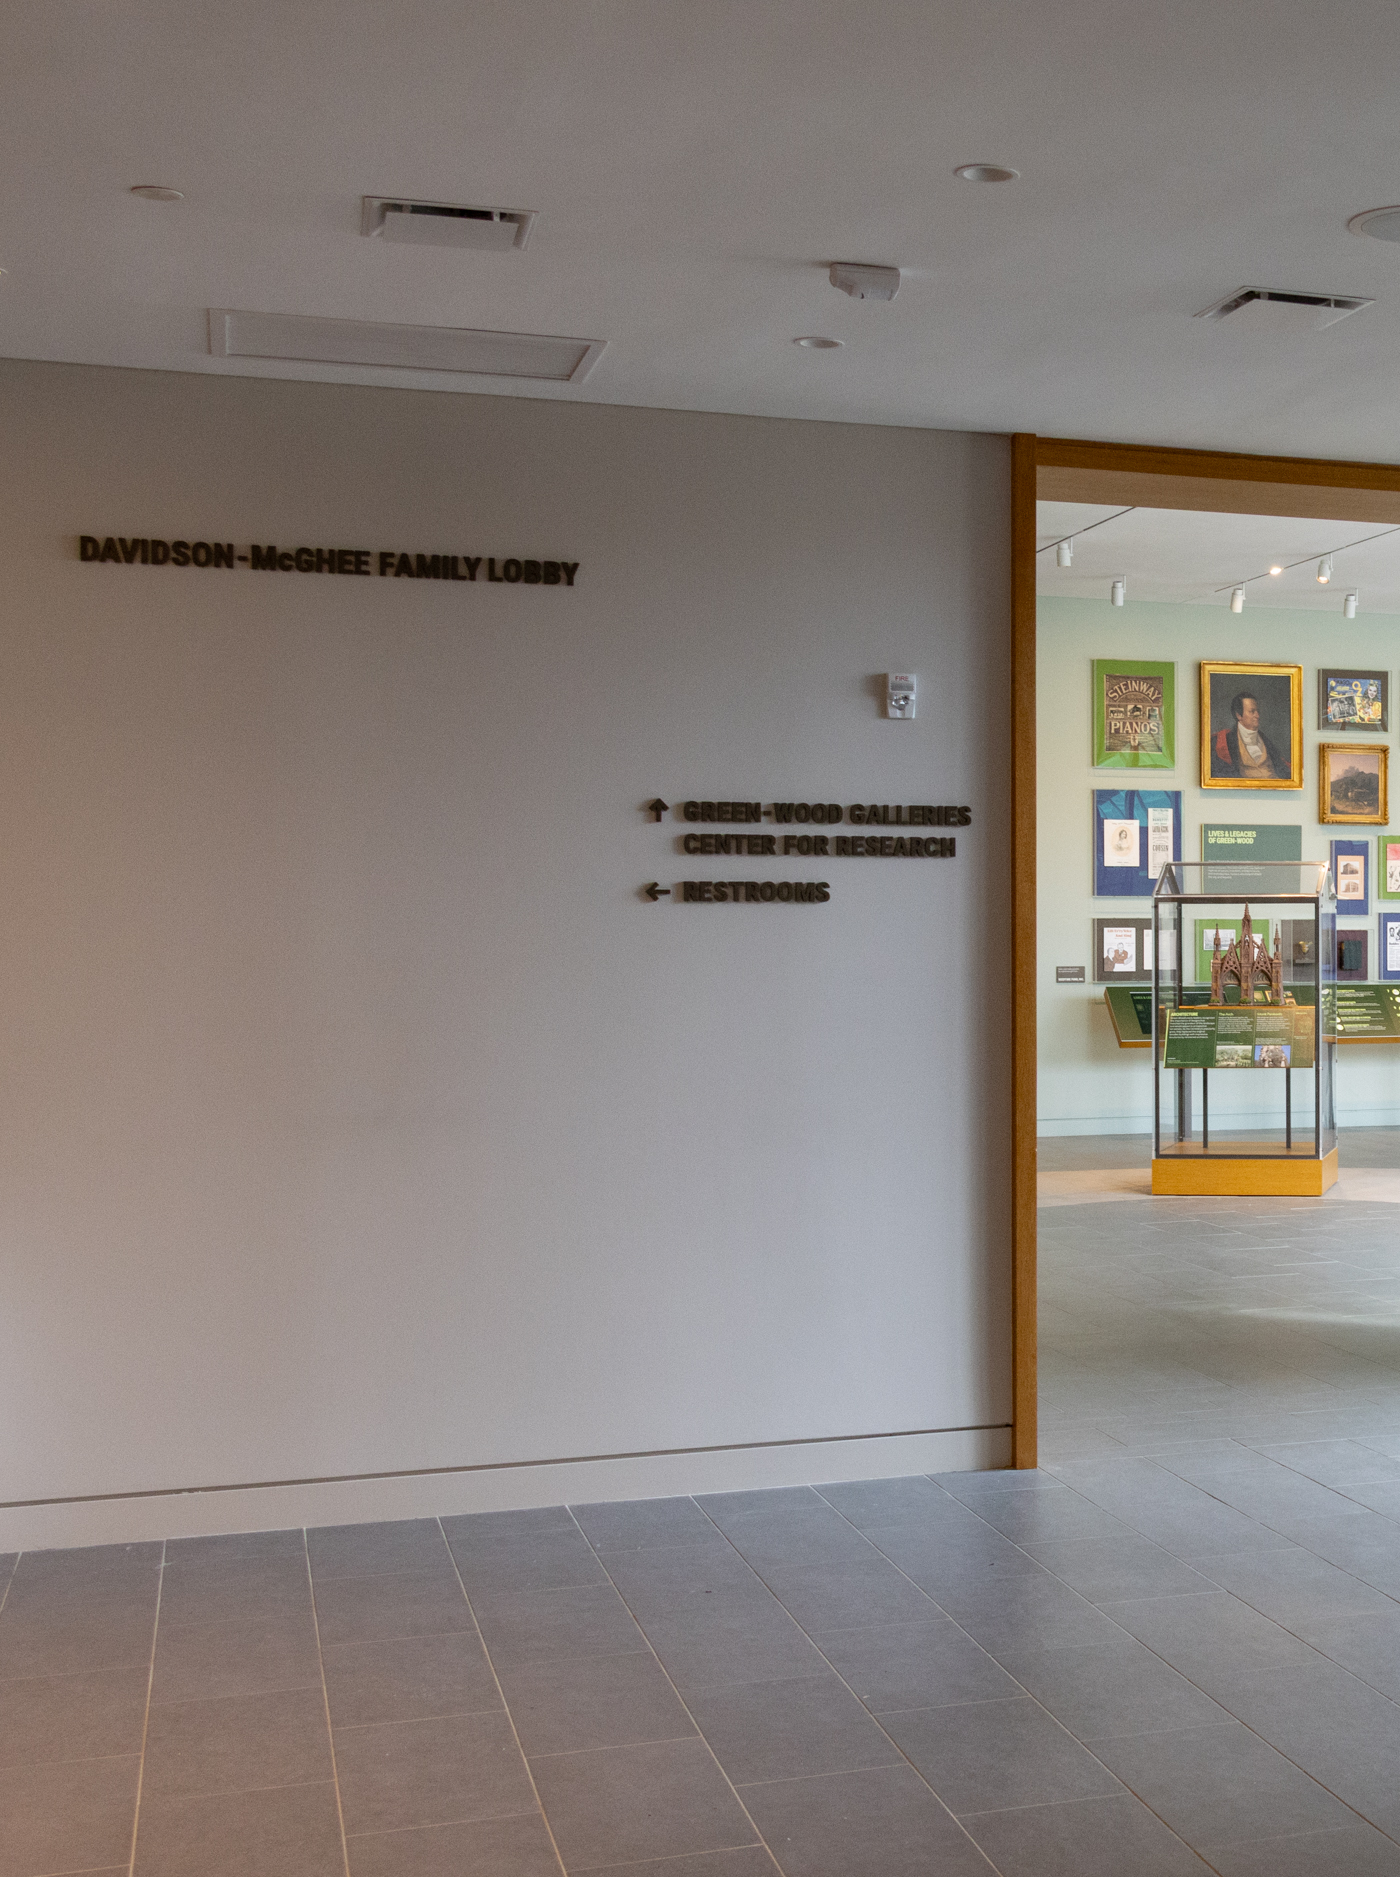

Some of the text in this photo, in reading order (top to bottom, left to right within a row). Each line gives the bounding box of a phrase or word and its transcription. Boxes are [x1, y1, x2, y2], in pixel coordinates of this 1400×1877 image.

[79, 535, 580, 587] DAVIDSON-McGHEE FAMILY LOBBY
[1107, 680, 1162, 701] STEINWAY
[1110, 721, 1159, 734] PIANOS
[682, 800, 973, 827] GREEN-WOOD GALLERIES
[1208, 830, 1225, 838] LIVES
[1230, 830, 1257, 838] LEGACIES
[1217, 837, 1255, 845] GREEN-WOOD
[682, 833, 957, 858] CENTER FOR RESEARCH
[682, 880, 831, 903] RESTROOMS
